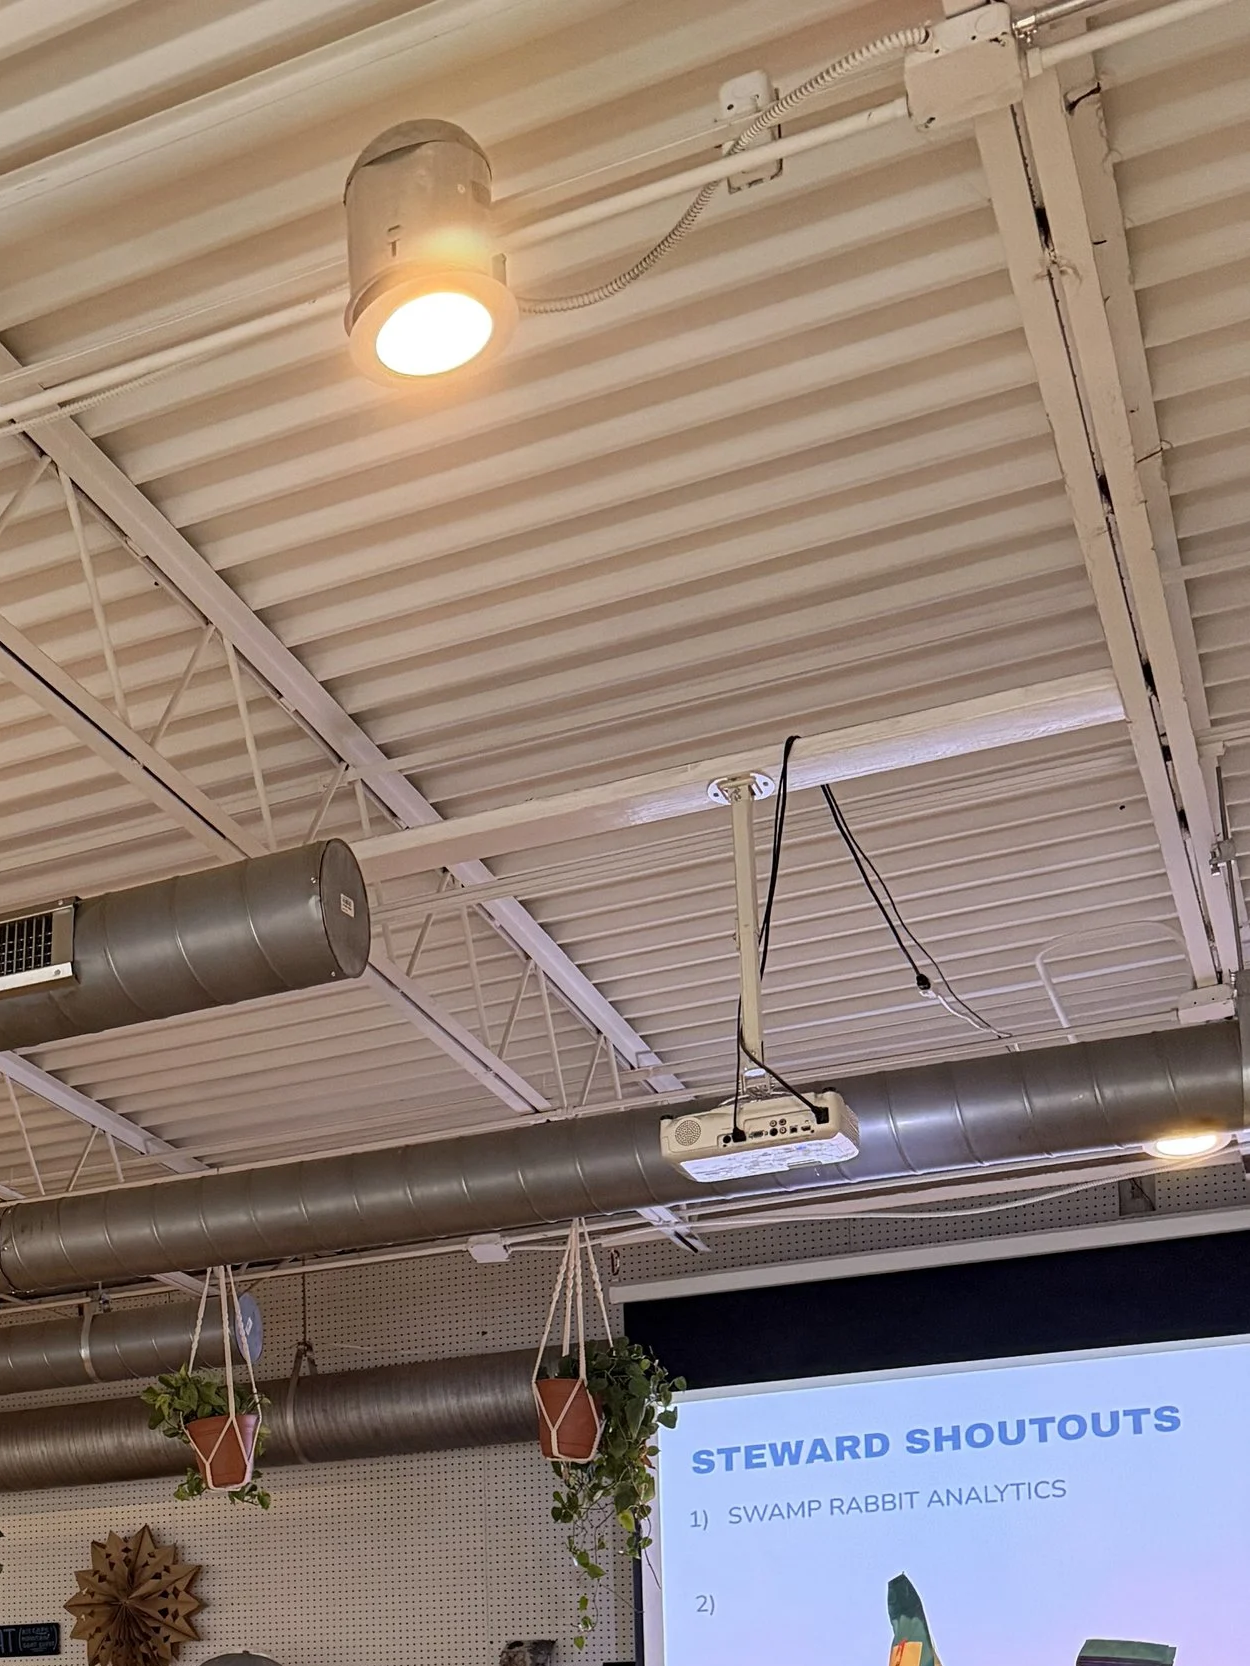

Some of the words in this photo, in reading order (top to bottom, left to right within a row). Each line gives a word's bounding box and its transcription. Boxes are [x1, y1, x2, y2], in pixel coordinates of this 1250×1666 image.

[691, 1433, 891, 1475] STEWARD
[905, 1405, 1182, 1455] SHOUTOUTS
[689, 1508, 710, 1530] 1)
[728, 1499, 822, 1525] SWAMP
[830, 1490, 920, 1517] RABBIT
[928, 1479, 1067, 1508] ANALYTICS
[696, 1594, 717, 1616] 2)
